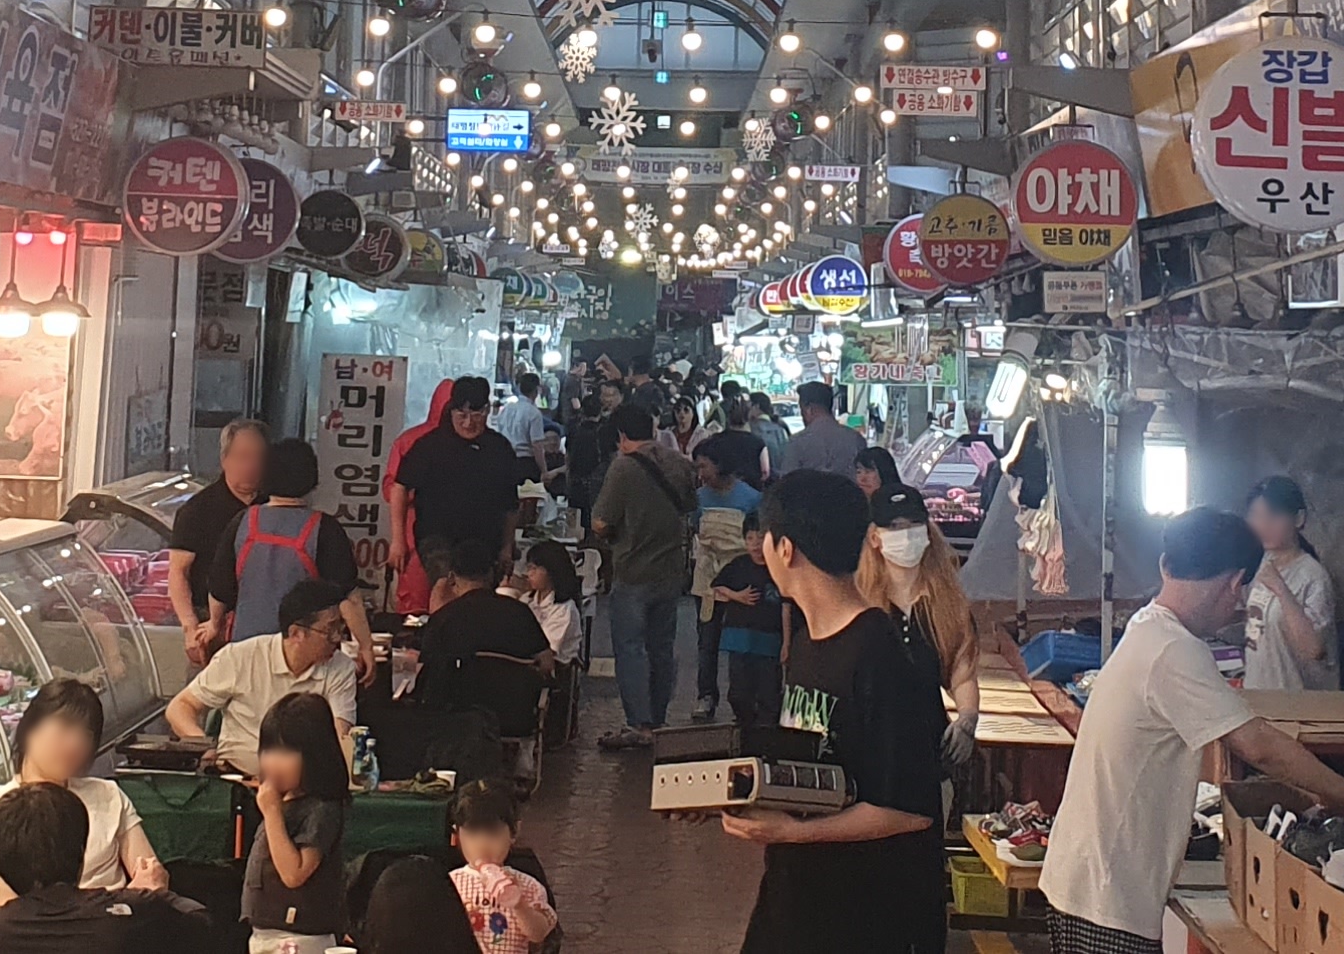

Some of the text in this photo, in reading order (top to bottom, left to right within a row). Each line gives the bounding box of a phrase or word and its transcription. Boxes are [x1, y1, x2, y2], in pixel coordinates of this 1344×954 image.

[898, 67, 968, 85] 연결송수관 방수구
[1261, 49, 1333, 84] 장갑
[146, 156, 221, 192] 커텐
[1026, 167, 1121, 216] 야채
[1256, 178, 1335, 216] 우산
[1042, 227, 1112, 247] 믿음 야채
[930, 242, 1000, 269] 방앗간
[819, 268, 857, 291] 생선
[334, 358, 394, 382] 남·여
[333, 385, 386, 536] 머리염색
